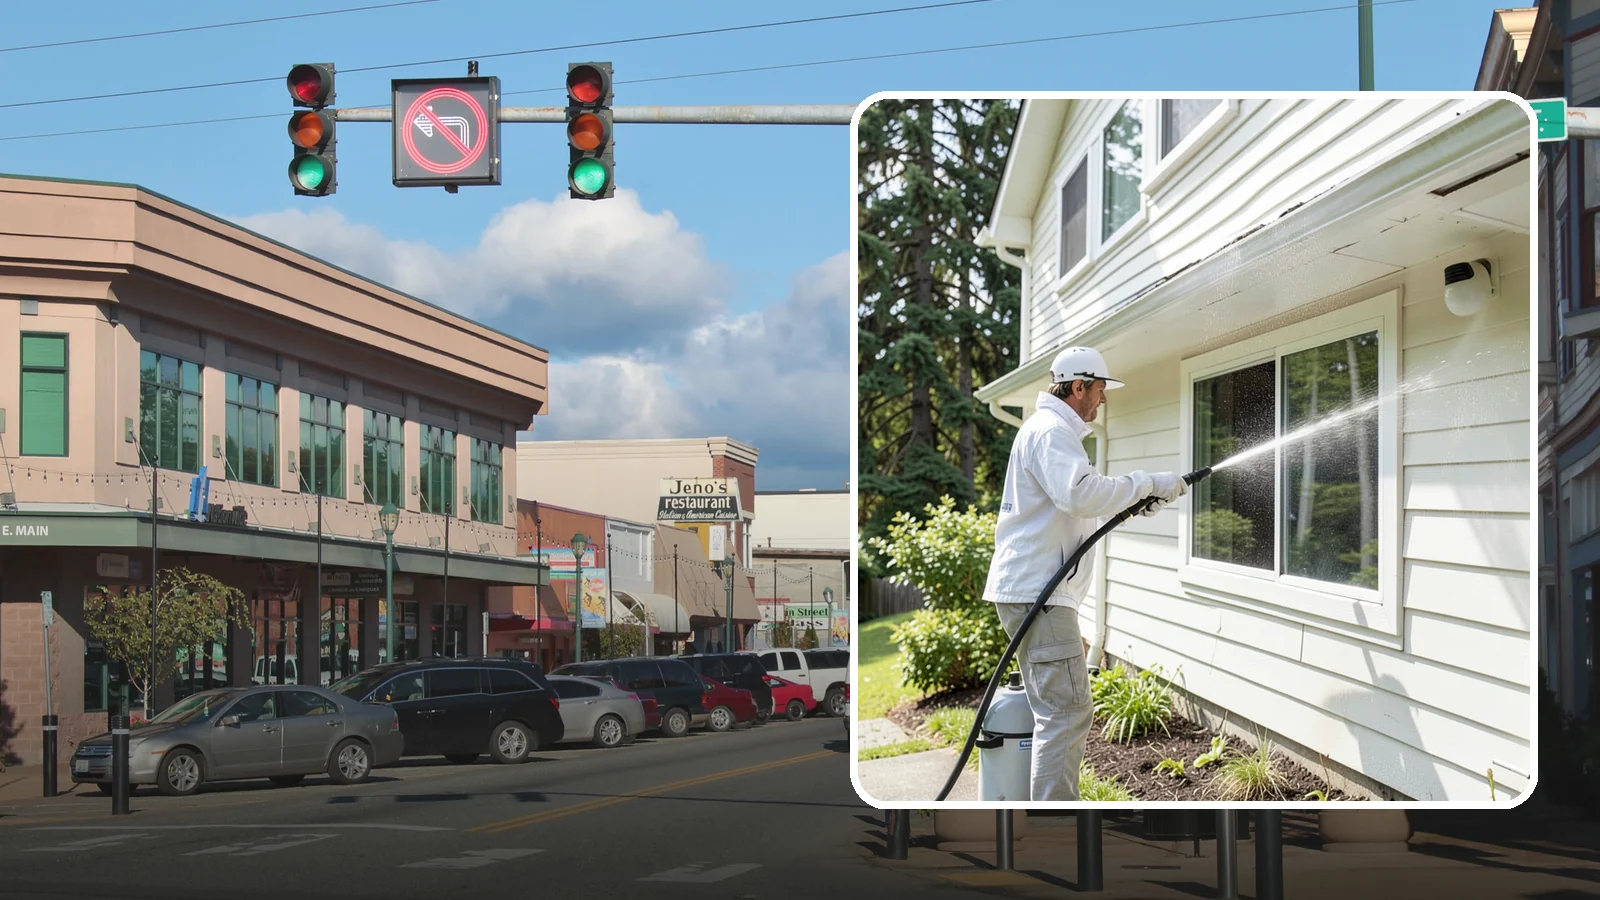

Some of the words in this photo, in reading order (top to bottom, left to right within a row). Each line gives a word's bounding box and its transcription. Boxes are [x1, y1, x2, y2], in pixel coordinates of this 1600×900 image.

[669, 480, 727, 494] Jeno's
[665, 497, 731, 509] restaurant
[686, 510, 714, 520] American
[714, 509, 737, 519] Cuisine
[2, 525, 13, 536] E.
[15, 525, 49, 536] MAIN
[797, 608, 828, 616] Street
[790, 619, 823, 627] lass
